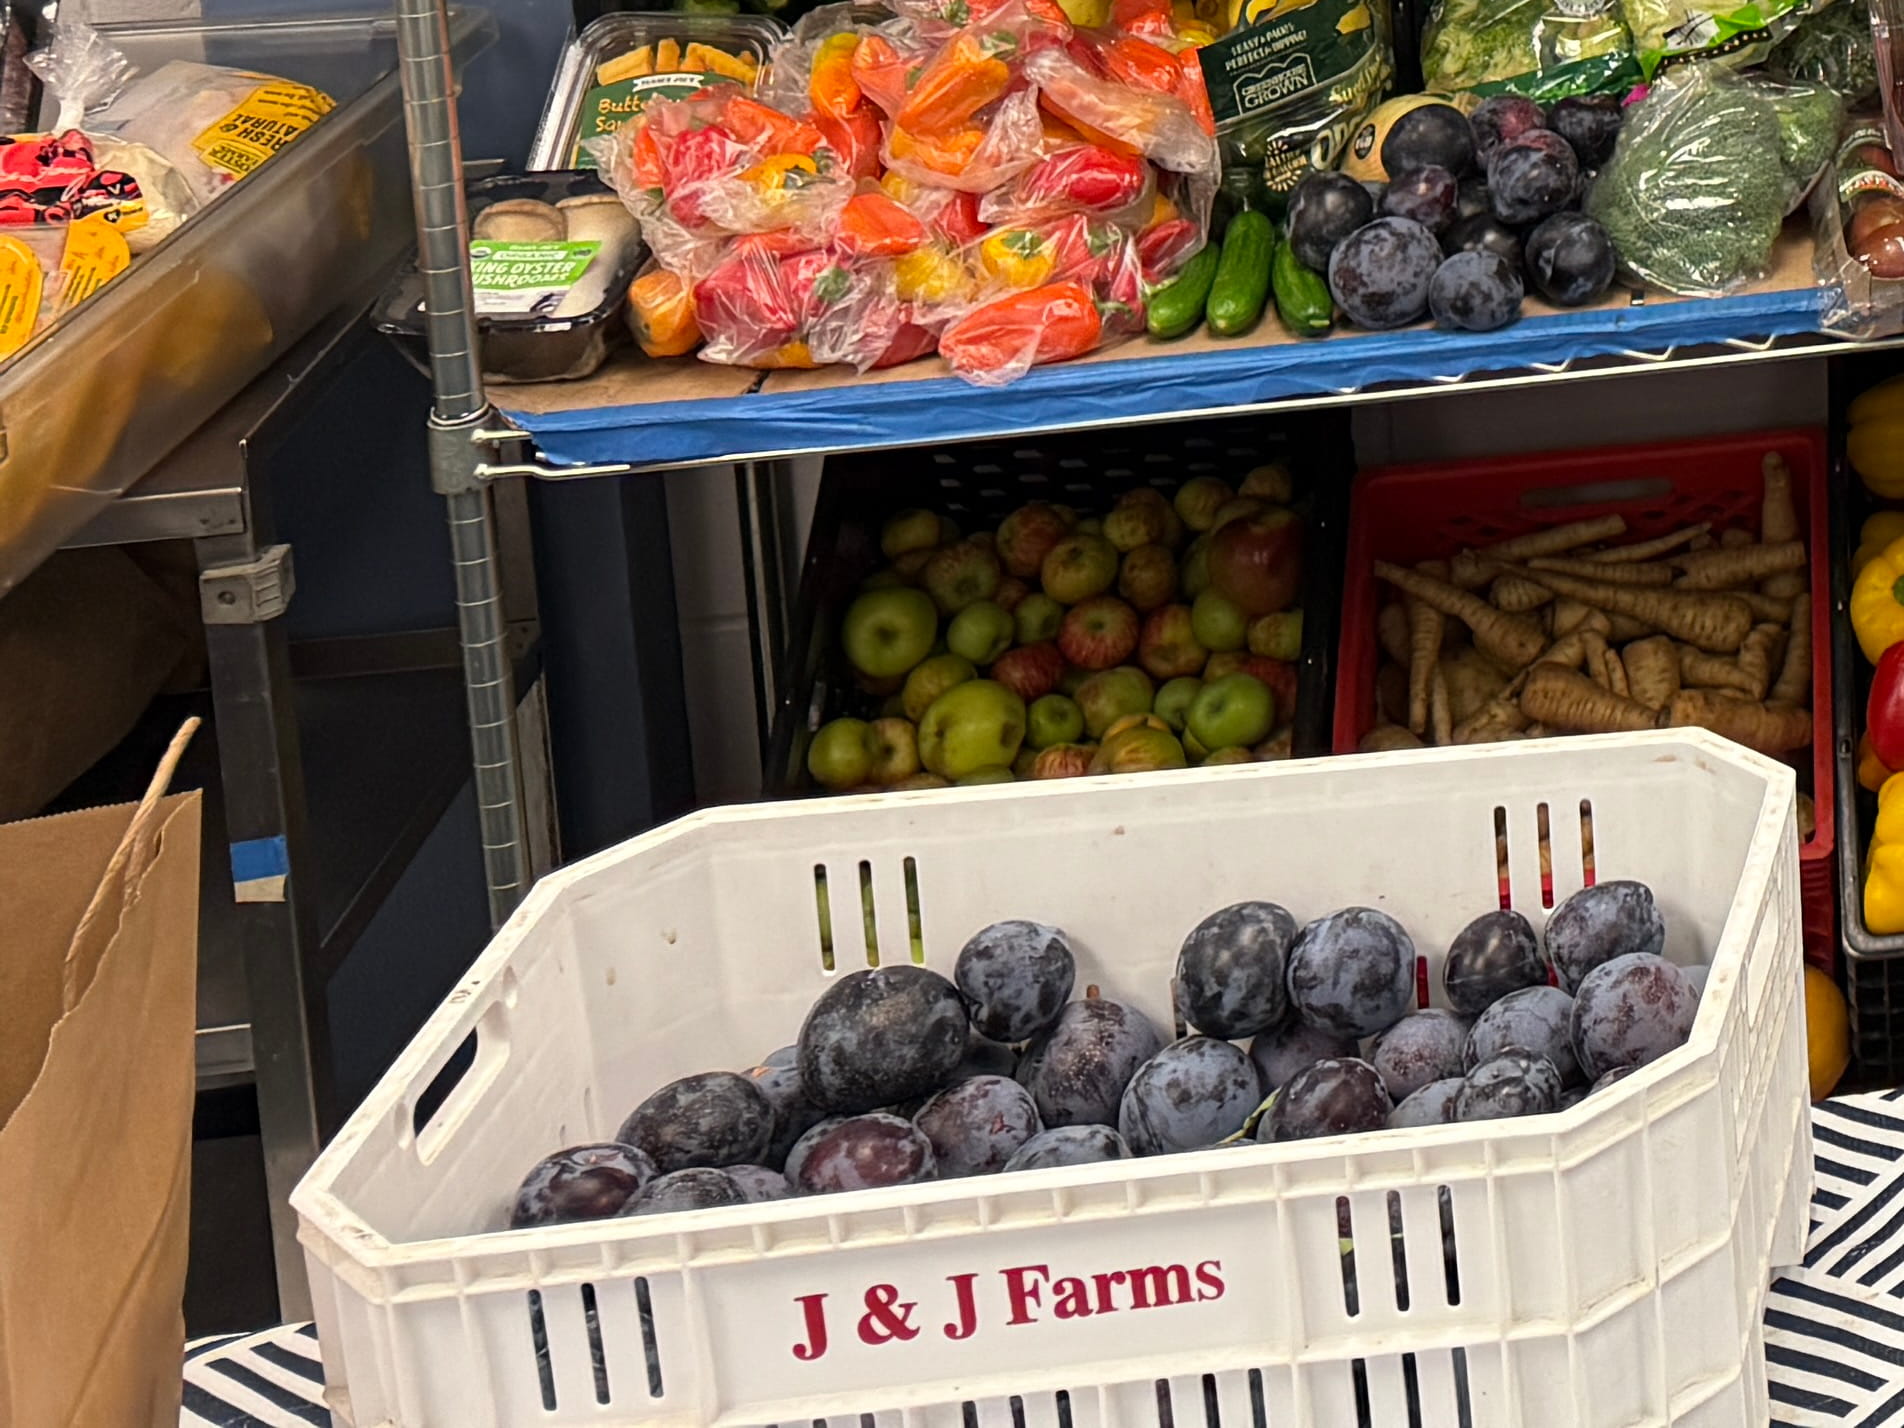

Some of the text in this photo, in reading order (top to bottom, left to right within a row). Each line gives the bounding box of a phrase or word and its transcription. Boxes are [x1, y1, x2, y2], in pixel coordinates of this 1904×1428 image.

[1244, 73, 1309, 108] GROWN
[473, 272, 569, 287] USHROOMS
[511, 261, 576, 274] OYSTER
[792, 1259, 1226, 1361] J & J Farms
